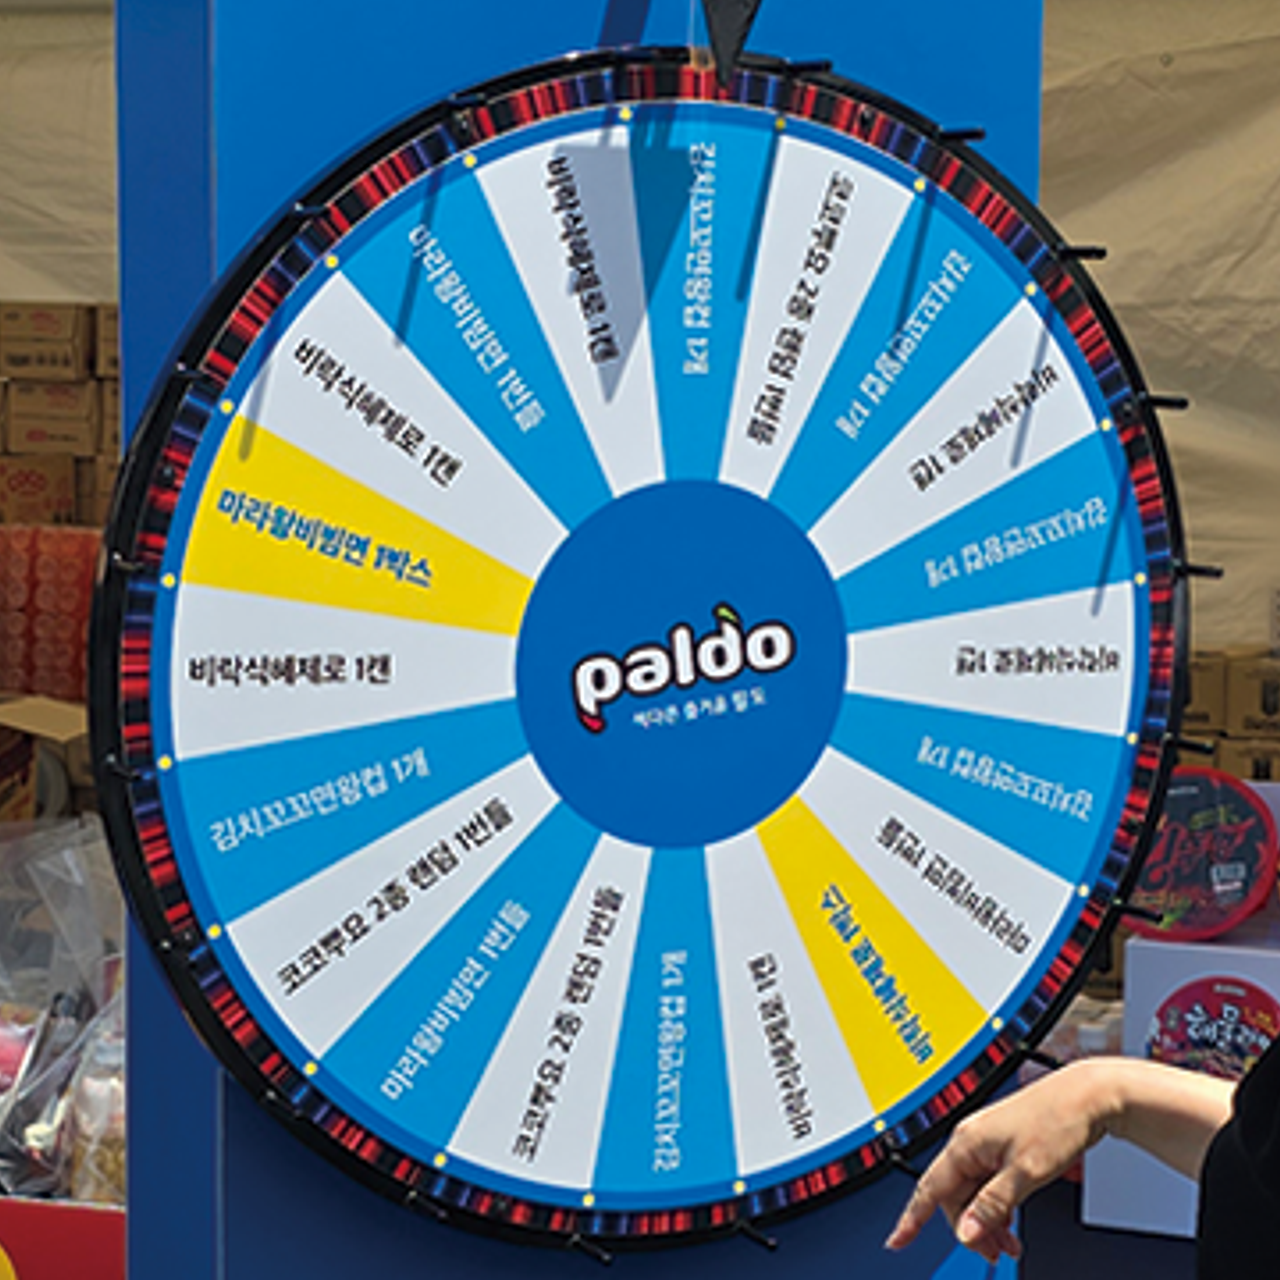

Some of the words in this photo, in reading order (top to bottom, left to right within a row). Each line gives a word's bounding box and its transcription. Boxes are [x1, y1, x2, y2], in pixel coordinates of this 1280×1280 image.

[683, 337, 708, 373] 1개
[835, 400, 869, 438] 1개
[573, 601, 796, 734] paldo
[391, 748, 428, 782] 1개
[661, 951, 686, 986] 1개
